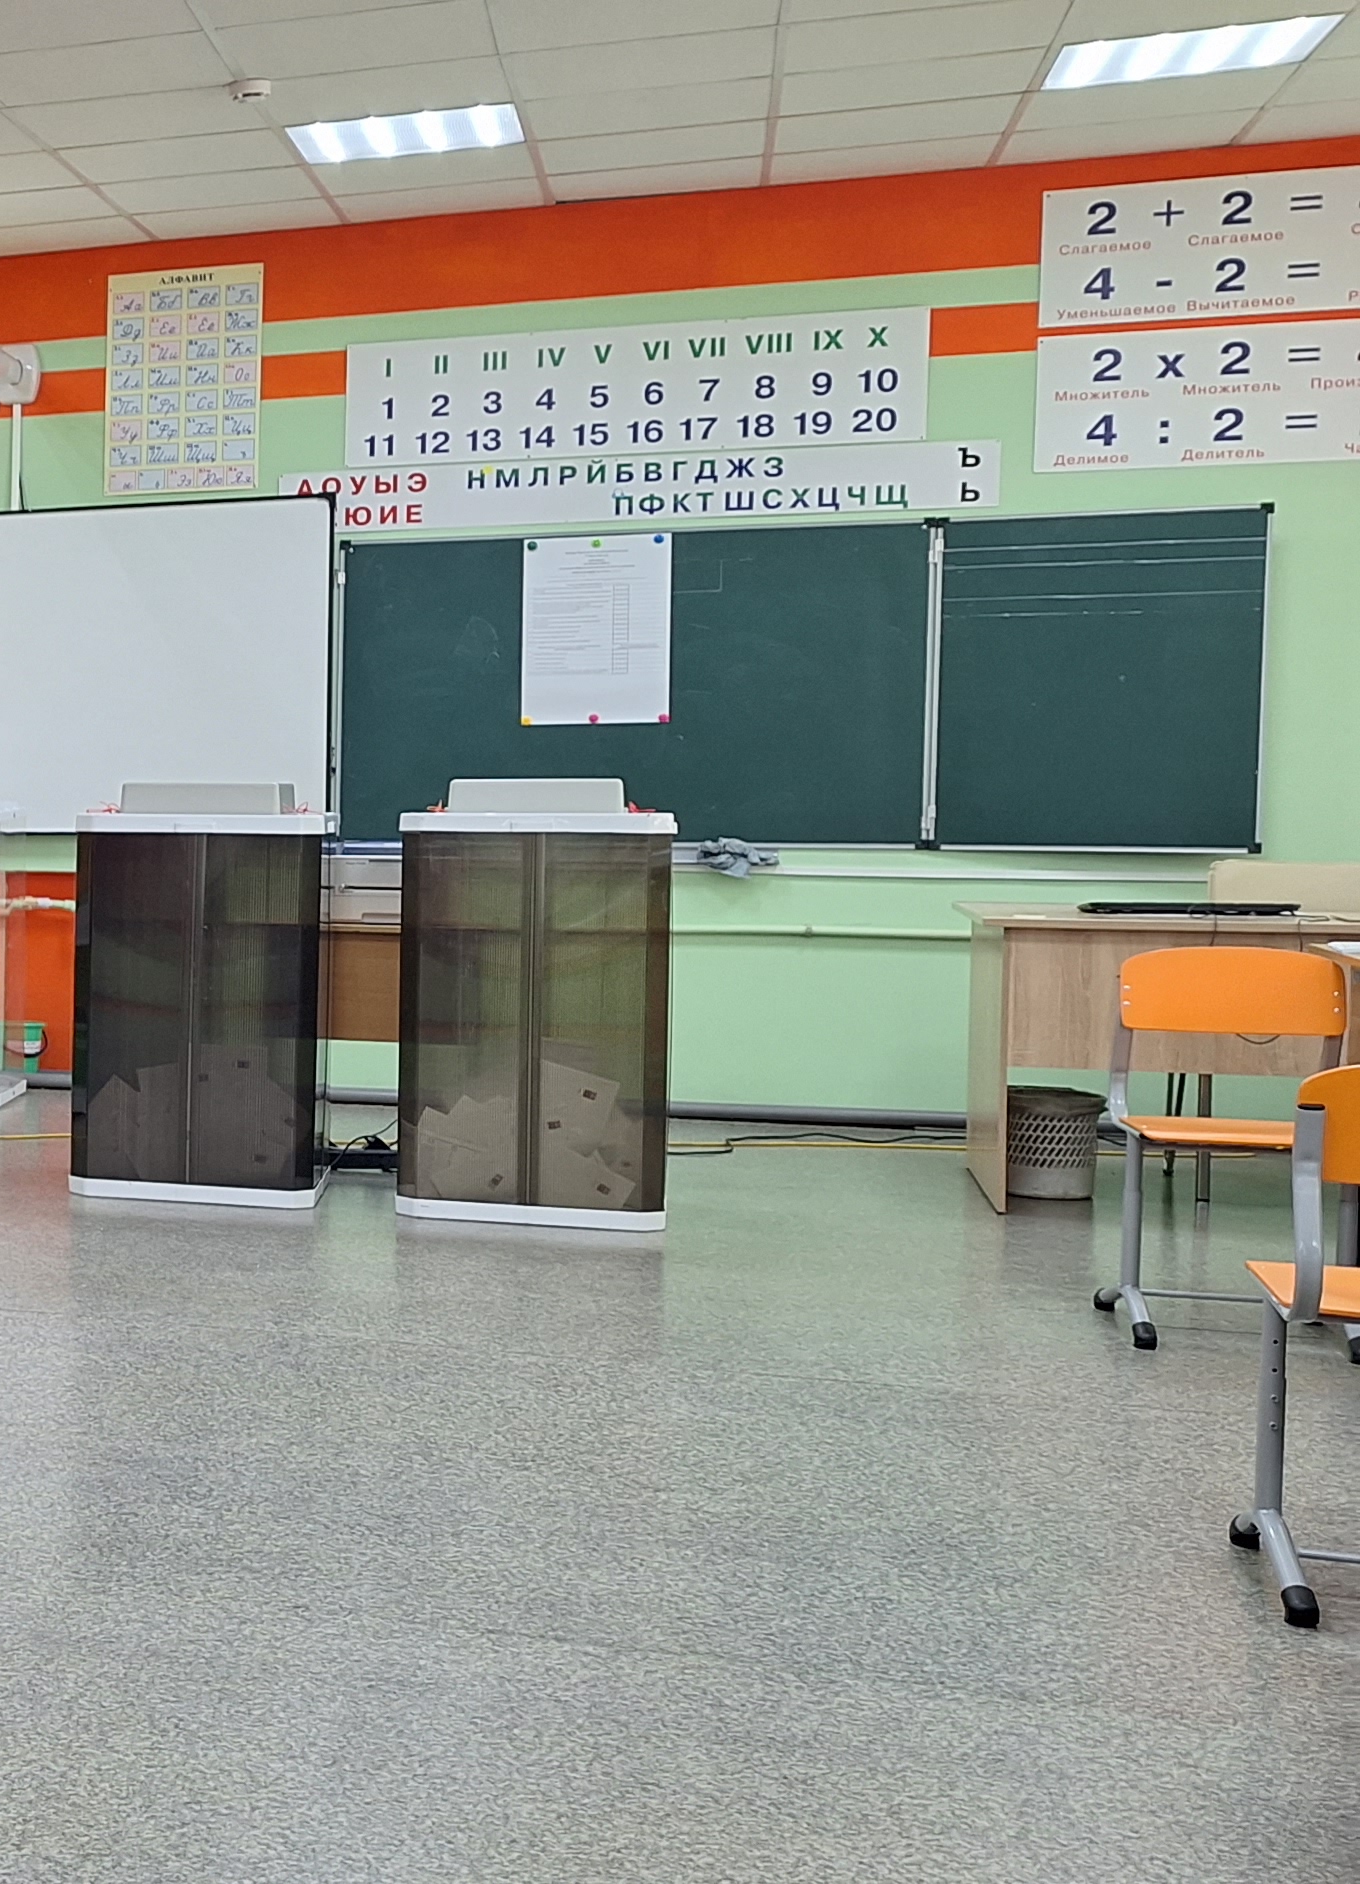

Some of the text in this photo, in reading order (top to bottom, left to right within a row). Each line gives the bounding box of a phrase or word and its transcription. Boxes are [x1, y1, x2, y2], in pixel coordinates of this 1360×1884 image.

[1088, 202, 1116, 235] 2
[1154, 200, 1184, 226] +
[1222, 191, 1252, 225] 2
[1291, 195, 1323, 210] =
[1059, 231, 1284, 255] Слагаемое Слагаемое
[159, 273, 214, 285] АЛФАВИТ
[1084, 268, 1114, 299] 4
[1216, 259, 1245, 292] 2
[1288, 263, 1320, 278] =
[1057, 295, 1295, 320] Уменьшаемое Вычитаемое
[386, 327, 887, 377] I II III IV V VI VII VIII IX X
[1093, 349, 1121, 381] 2
[1221, 342, 1250, 375] 2
[1289, 348, 1320, 362] =
[383, 369, 897, 419] 1 2 3 4 5 6 7 8 9 10
[1055, 387, 1150, 402] Множитель
[1182, 382, 1281, 395] Множитель
[365, 408, 896, 456] 11 12 13 14 15 16 17 18 19 20
[1087, 409, 1317, 446] 4 : 2 =
[1053, 448, 1265, 466] Делимое Делитель
